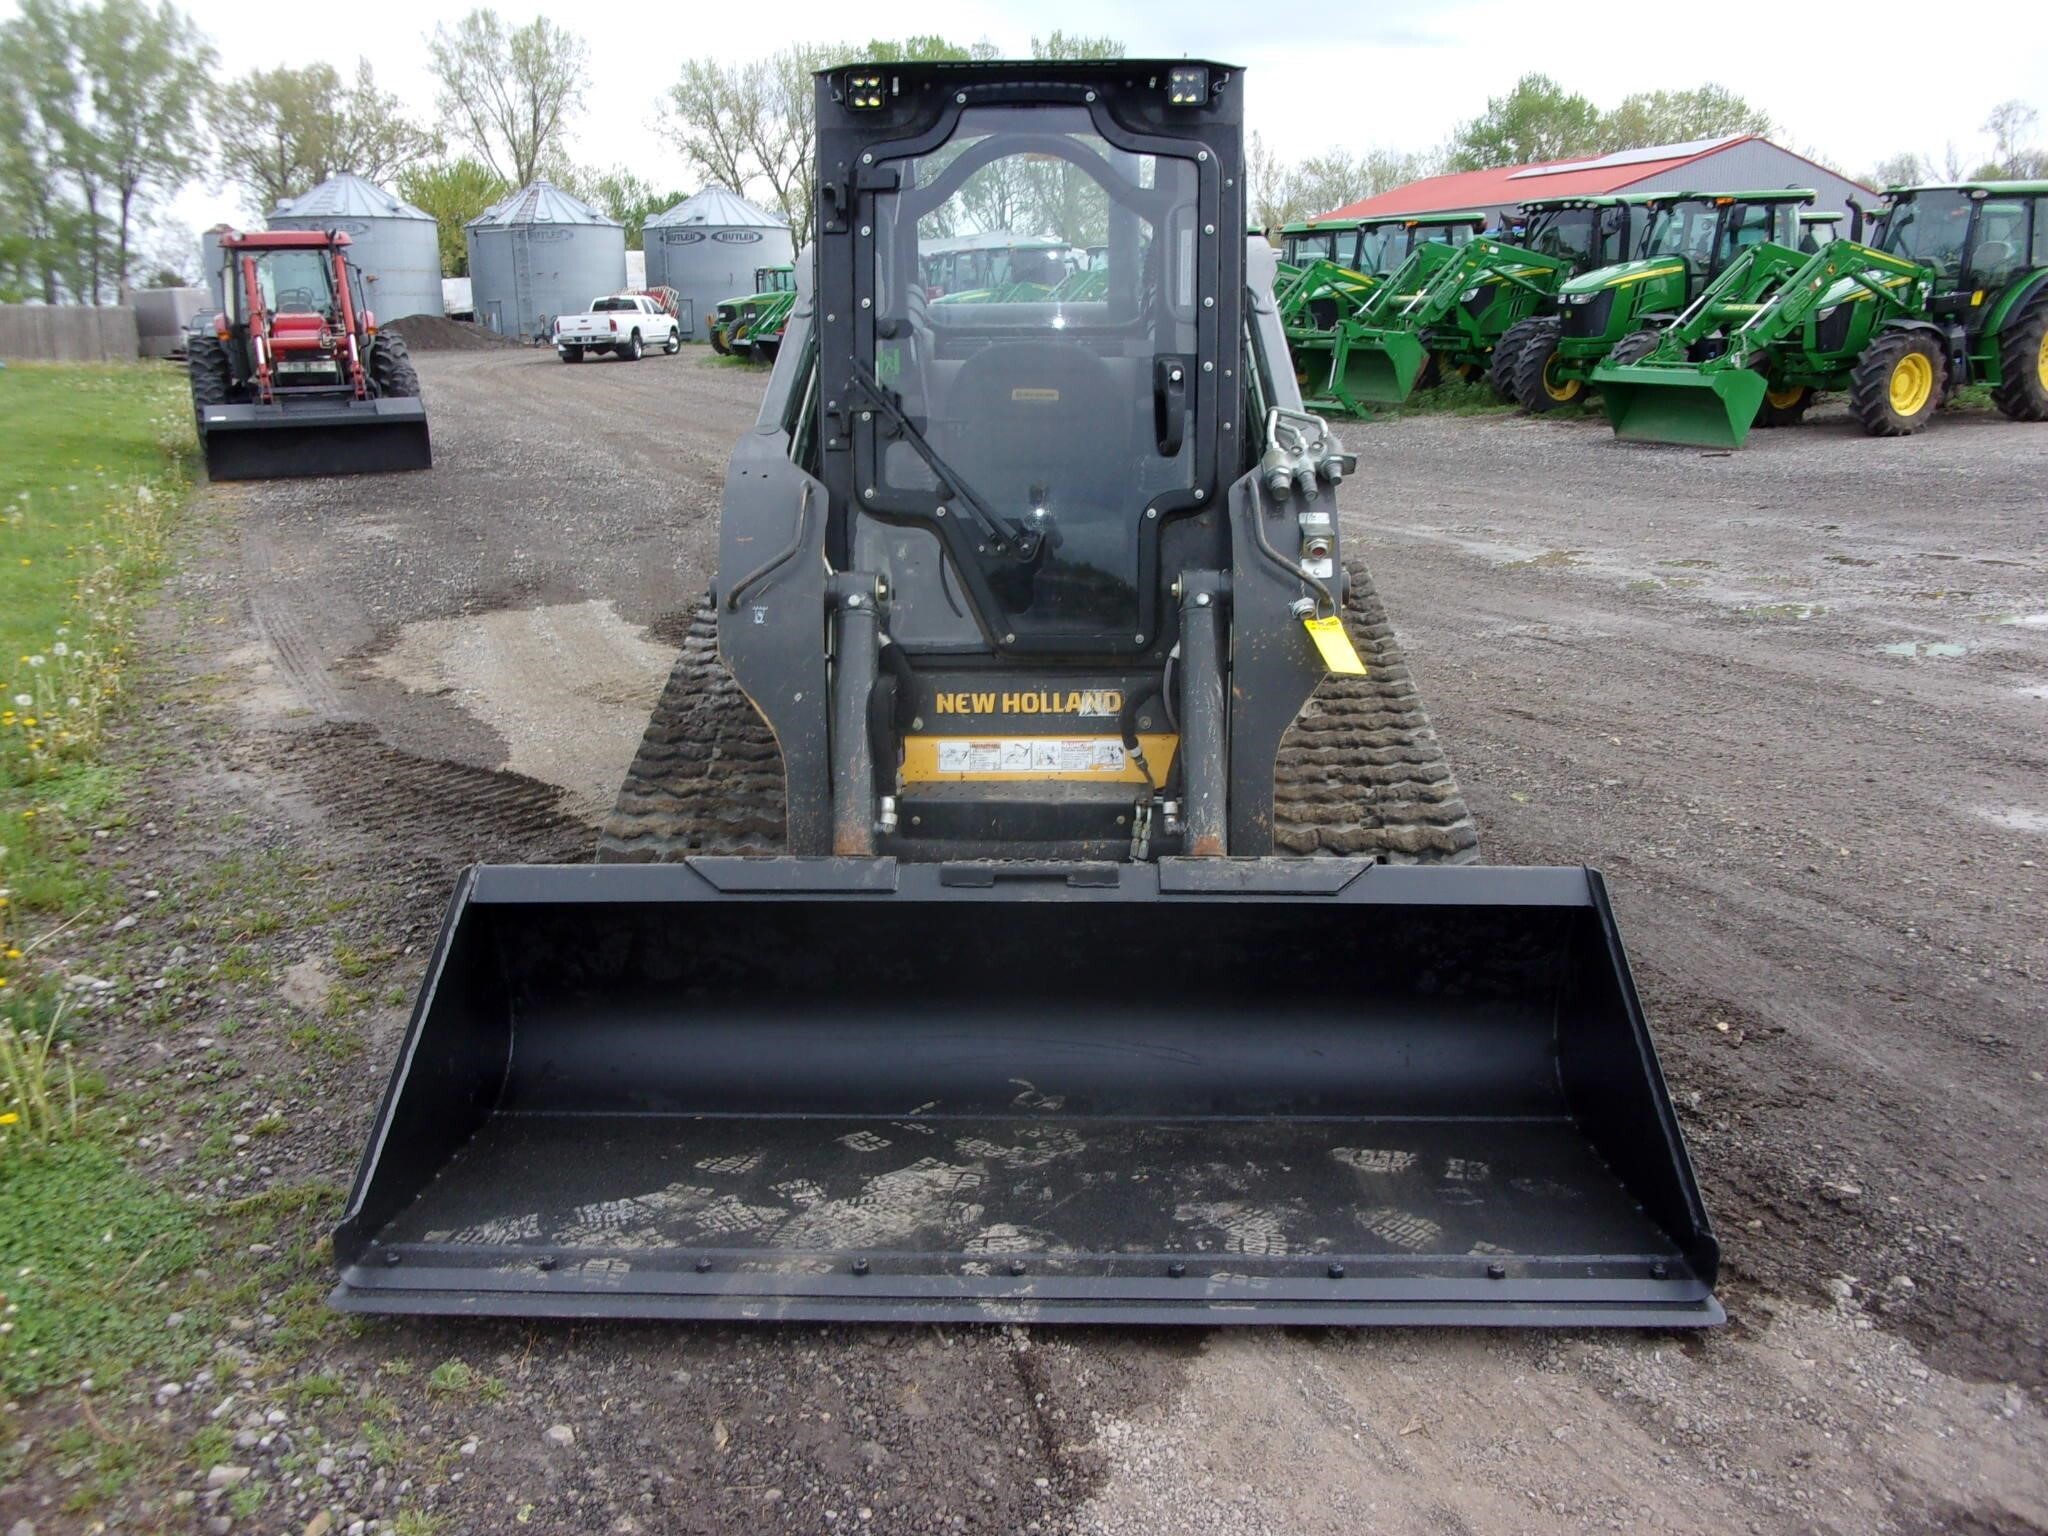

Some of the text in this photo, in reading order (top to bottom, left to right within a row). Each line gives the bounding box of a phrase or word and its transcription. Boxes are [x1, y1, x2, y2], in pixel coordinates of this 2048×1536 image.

[722, 232, 754, 241] BUTLER
[936, 692, 1122, 714] NEW HOLLAND
